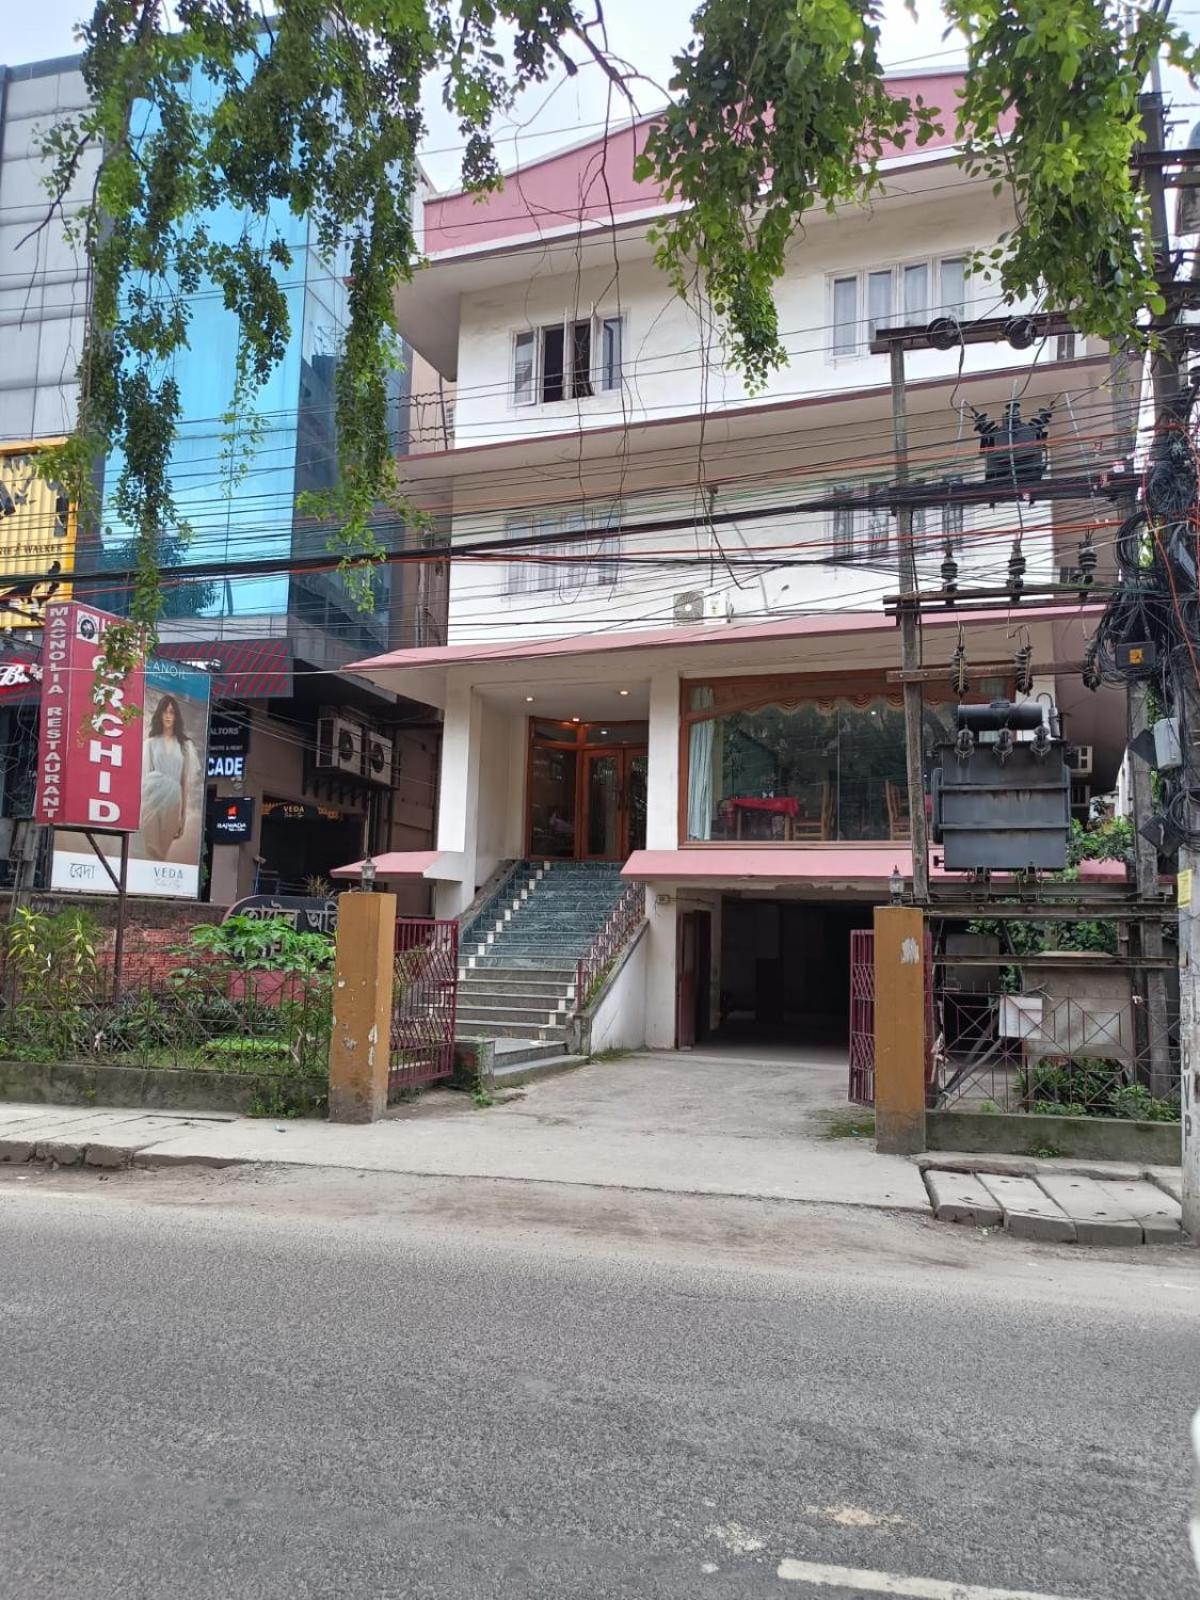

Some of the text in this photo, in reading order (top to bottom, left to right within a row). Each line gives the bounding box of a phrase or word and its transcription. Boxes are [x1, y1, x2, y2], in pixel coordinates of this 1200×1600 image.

[42, 707, 62, 818] RESTAURANT
[283, 805, 305, 814] VEDA
[154, 866, 183, 879] VEDA
